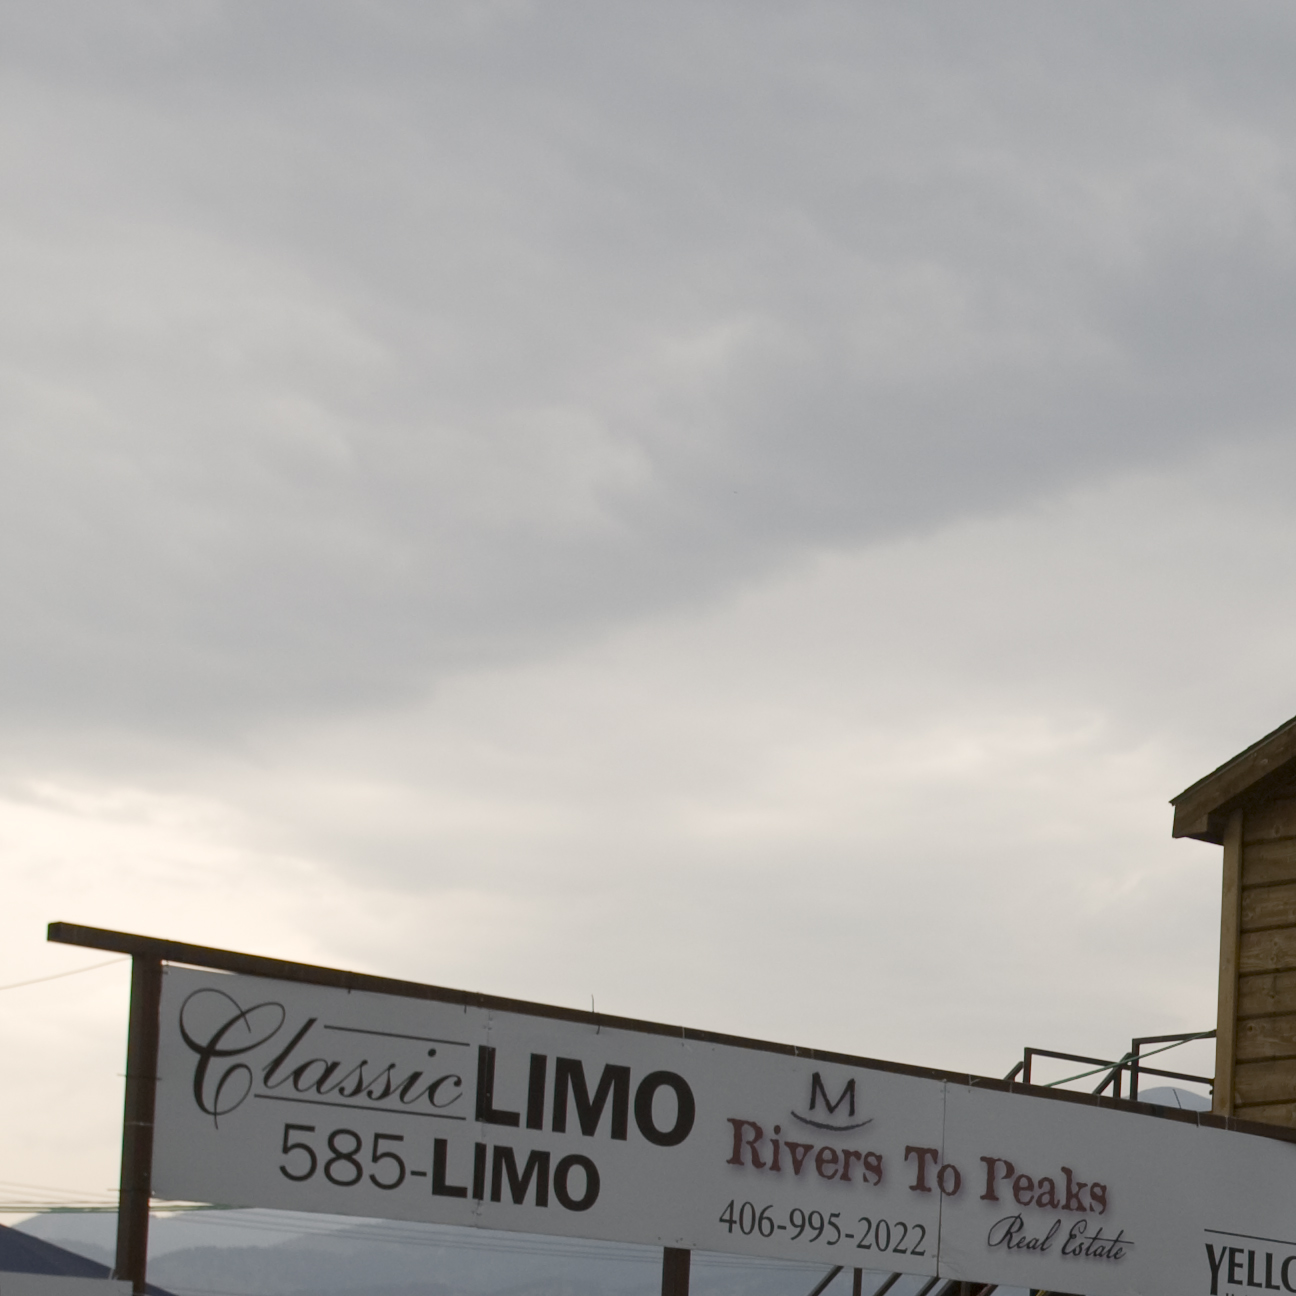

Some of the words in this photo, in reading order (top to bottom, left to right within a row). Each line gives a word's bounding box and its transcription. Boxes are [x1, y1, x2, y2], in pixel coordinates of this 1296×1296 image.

[179, 987, 464, 1130] Classic
[474, 1044, 696, 1147] LIMO
[278, 1122, 601, 1212] 585-LIMO
[726, 1117, 885, 1187] Rivers
[904, 1145, 962, 1197] To
[979, 1155, 1108, 1216] Peaks
[718, 1199, 927, 1257] 406-995-2022
[987, 1214, 1060, 1252] Real
[1060, 1219, 1135, 1261] Estate
